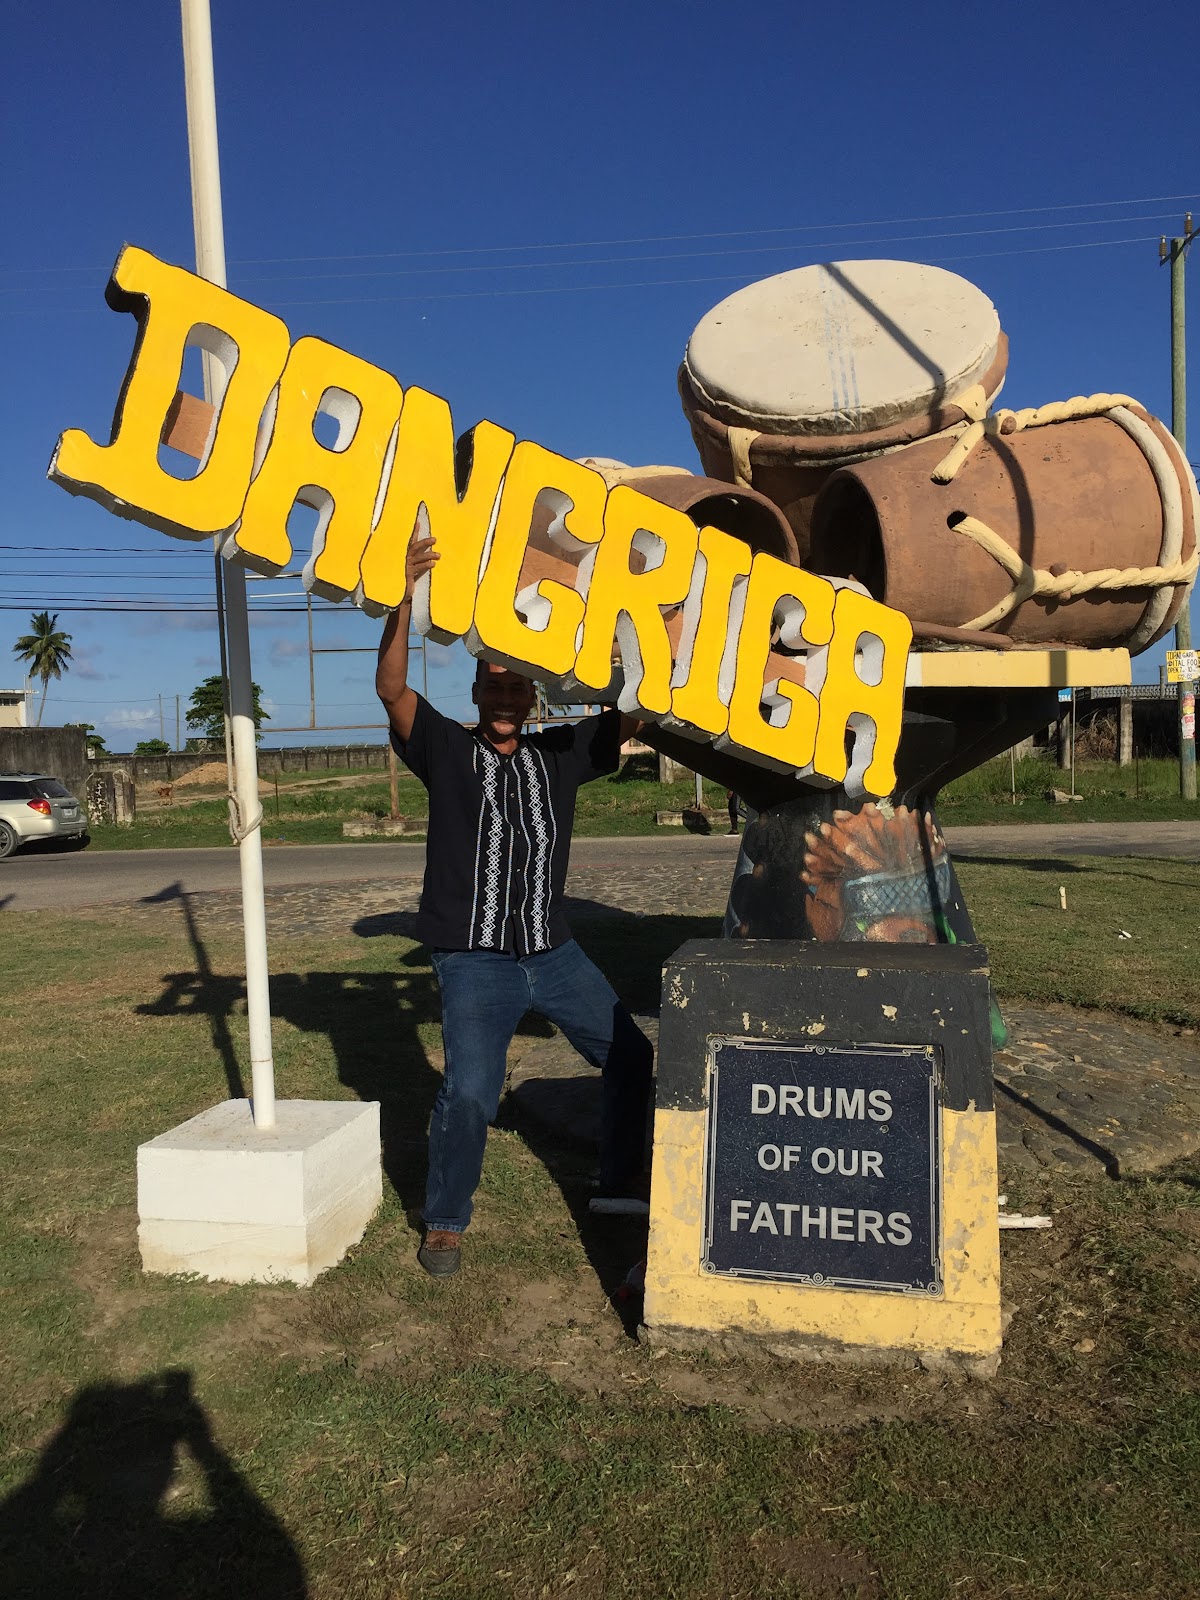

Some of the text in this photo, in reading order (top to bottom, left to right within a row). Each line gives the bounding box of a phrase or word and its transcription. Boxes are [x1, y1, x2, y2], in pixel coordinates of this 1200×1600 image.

[49, 243, 913, 799] DANGRIGA
[750, 1083, 894, 1122] DRUMS
[757, 1143, 885, 1178] OF OUR
[729, 1200, 913, 1247] FATHERS
